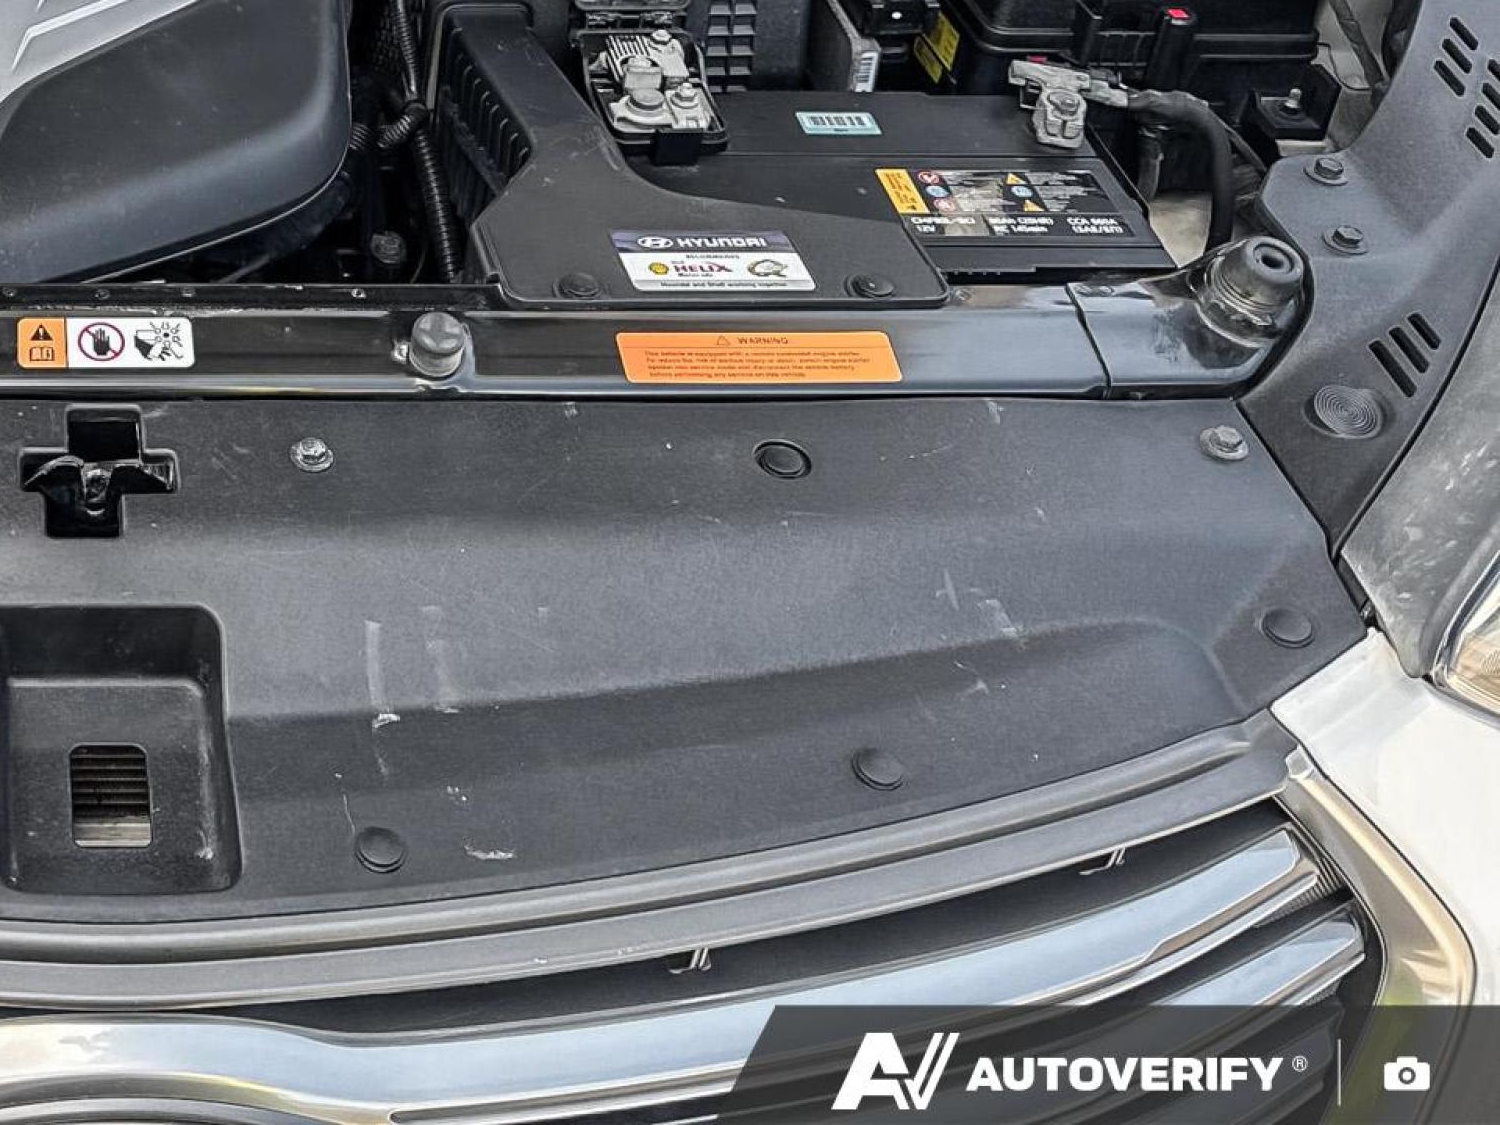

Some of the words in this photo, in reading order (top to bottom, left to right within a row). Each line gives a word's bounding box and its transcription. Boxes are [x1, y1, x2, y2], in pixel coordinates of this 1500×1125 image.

[676, 236, 767, 248] HYUNDAI
[672, 263, 733, 272] HELIX
[737, 336, 788, 344] WARNING
